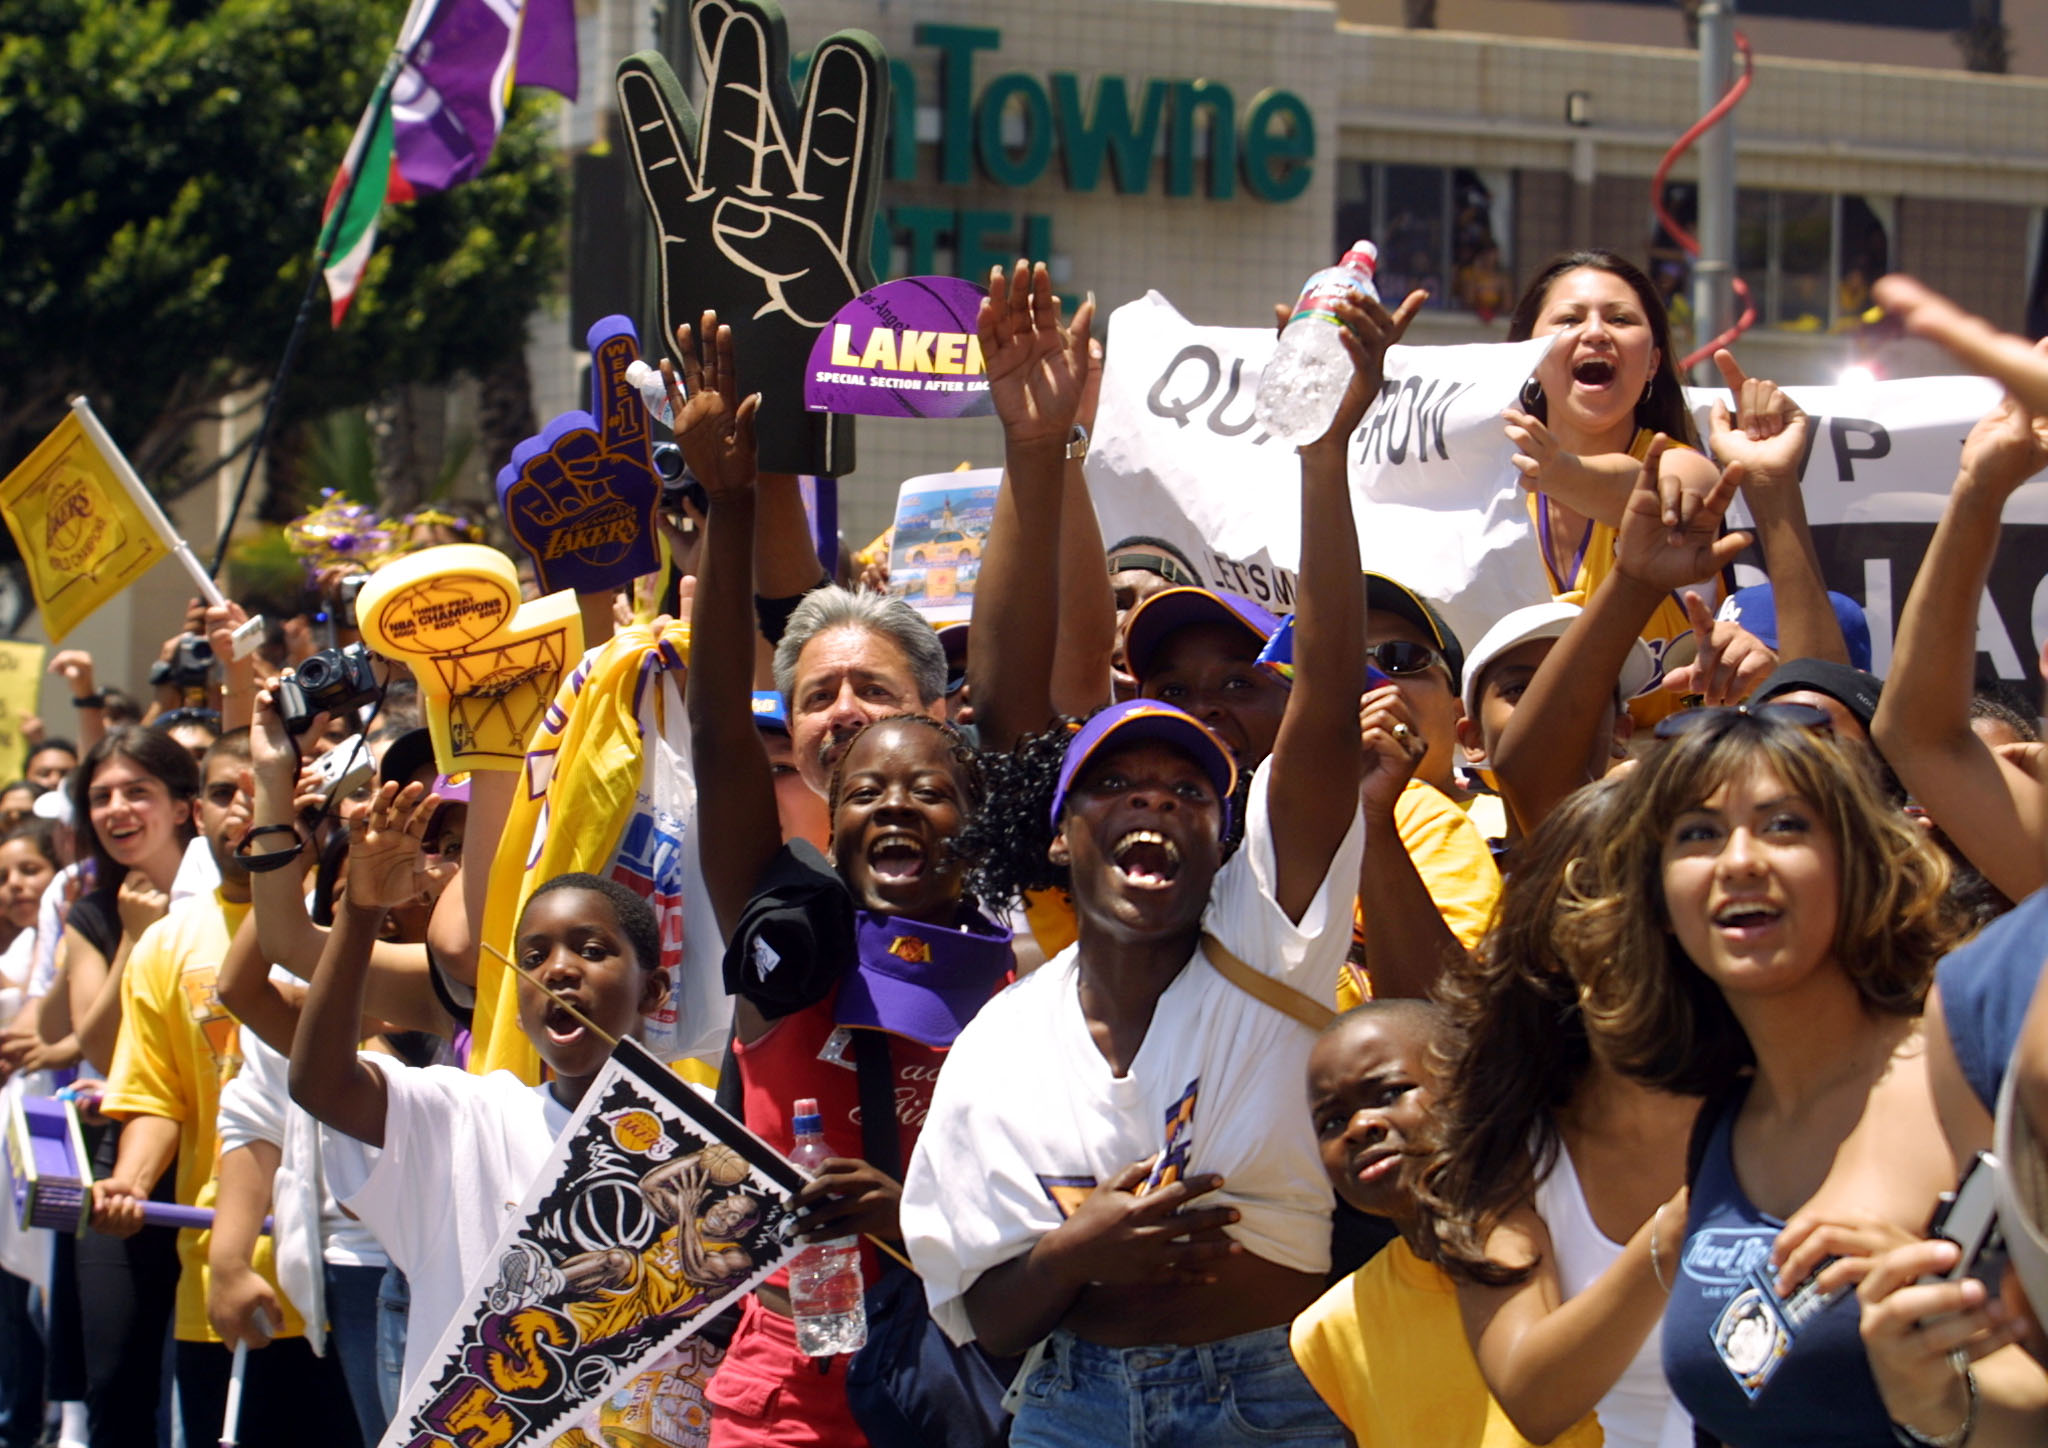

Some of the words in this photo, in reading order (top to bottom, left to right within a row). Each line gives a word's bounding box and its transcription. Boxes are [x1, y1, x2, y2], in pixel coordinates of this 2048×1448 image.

[815, 371, 867, 386] SPECIAL
[870, 375, 922, 391] SECTION
[924, 379, 964, 392] AFTER
[966, 380, 990, 392] EAC
[543, 518, 641, 560] LAKERS
[389, 618, 416, 633] NBA
[418, 597, 503, 627] CHAMPIONS
